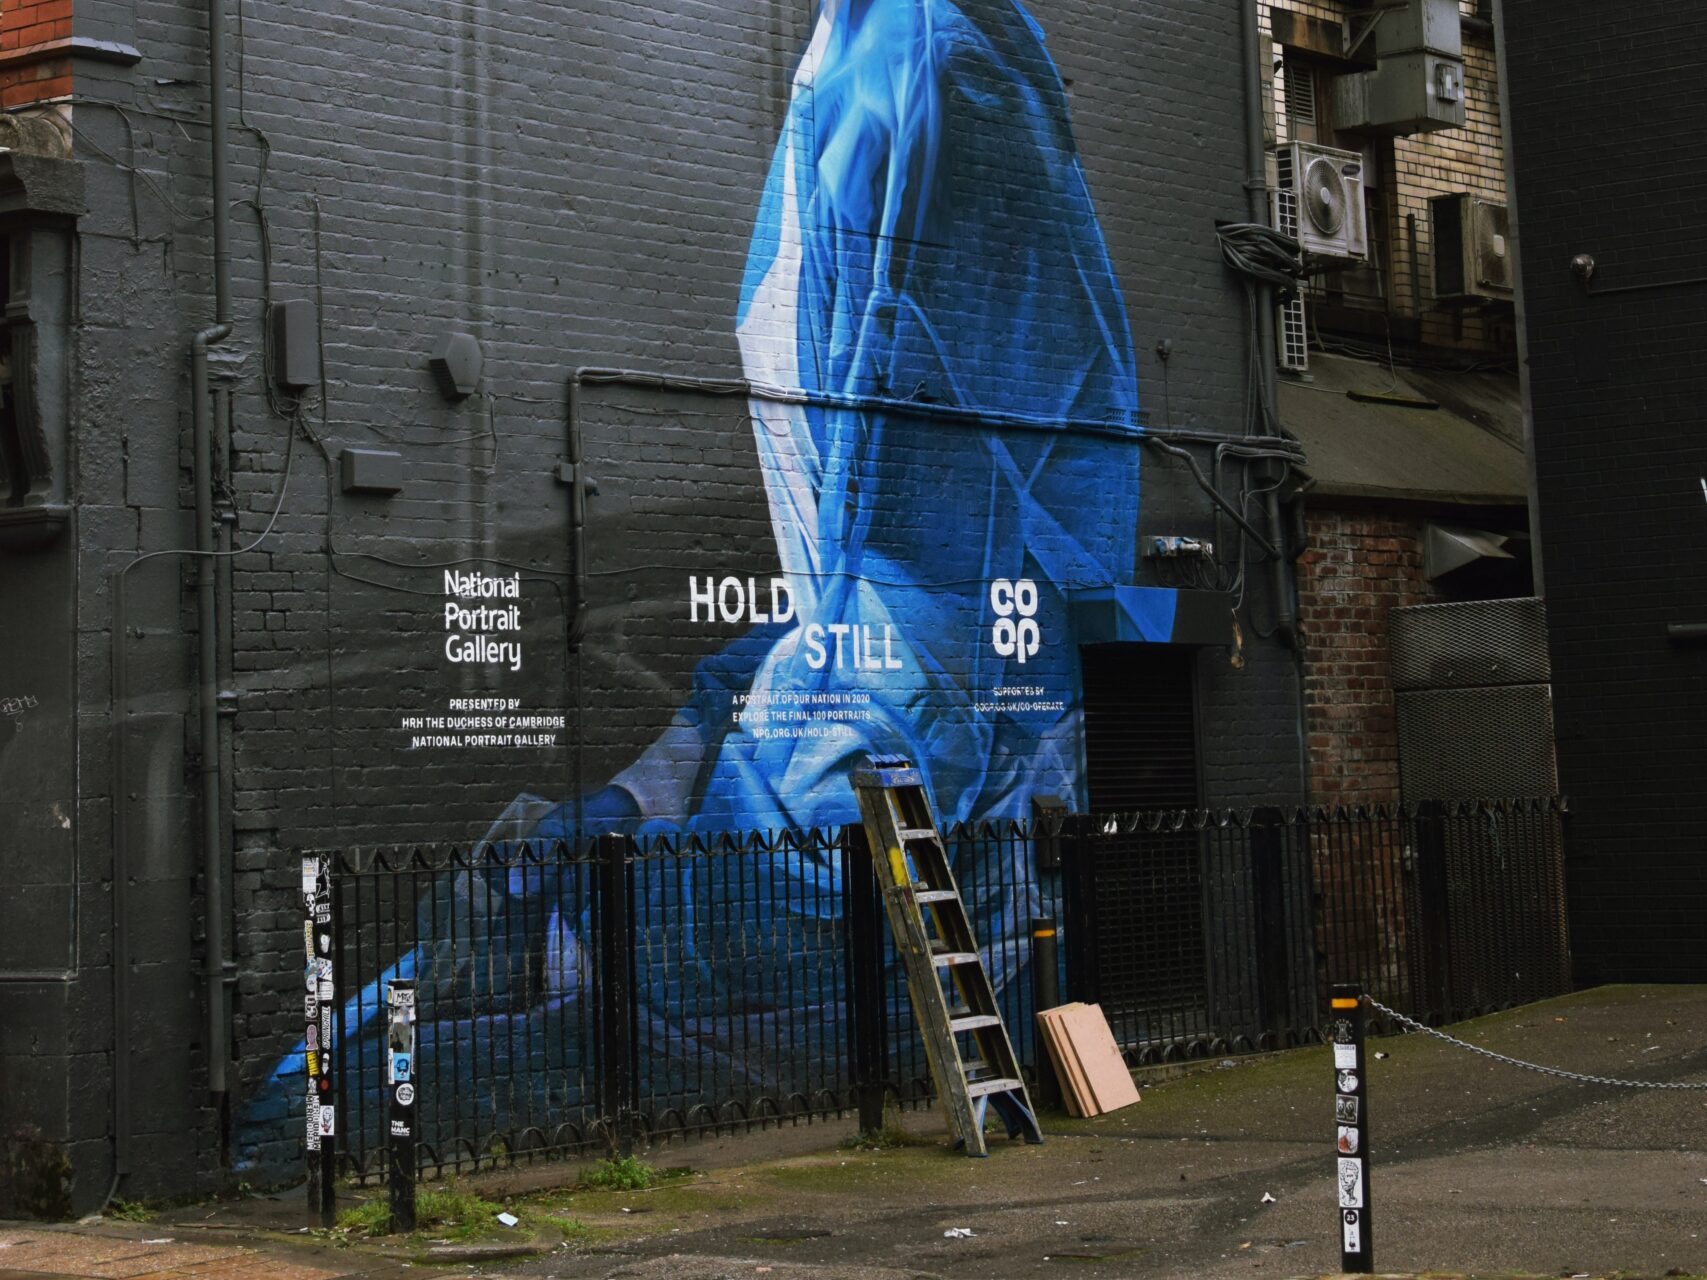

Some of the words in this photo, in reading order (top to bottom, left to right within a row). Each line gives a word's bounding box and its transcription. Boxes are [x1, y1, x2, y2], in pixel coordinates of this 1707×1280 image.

[444, 570, 520, 598] National
[689, 576, 795, 623] HOLD
[444, 602, 521, 631] Portrait
[445, 635, 521, 670] Gallery
[805, 623, 903, 669] STILL
[449, 698, 506, 710] PRESENTED
[508, 698, 520, 709] BY
[732, 694, 738, 705] A
[740, 694, 780, 705] PORTRAIT
[781, 694, 792, 704] OF
[793, 694, 810, 704] OUR
[811, 694, 840, 704] NATION
[842, 694, 851, 704] IN
[851, 693, 870, 704] 2020
[402, 717, 423, 729] HRH
[425, 717, 445, 729] THE
[447, 717, 493, 729] DUCHESS
[495, 717, 507, 728] OF
[509, 716, 566, 728] CAMBRIDGE
[732, 711, 769, 722] EXPLORE
[771, 711, 787, 721] THE
[788, 711, 811, 721] FINAL
[813, 711, 826, 720] 100
[827, 710, 871, 721] PORTRAITS
[411, 736, 463, 748] NATIONAL
[464, 735, 513, 747] PORTRAIT
[514, 734, 556, 747] GALLERY
